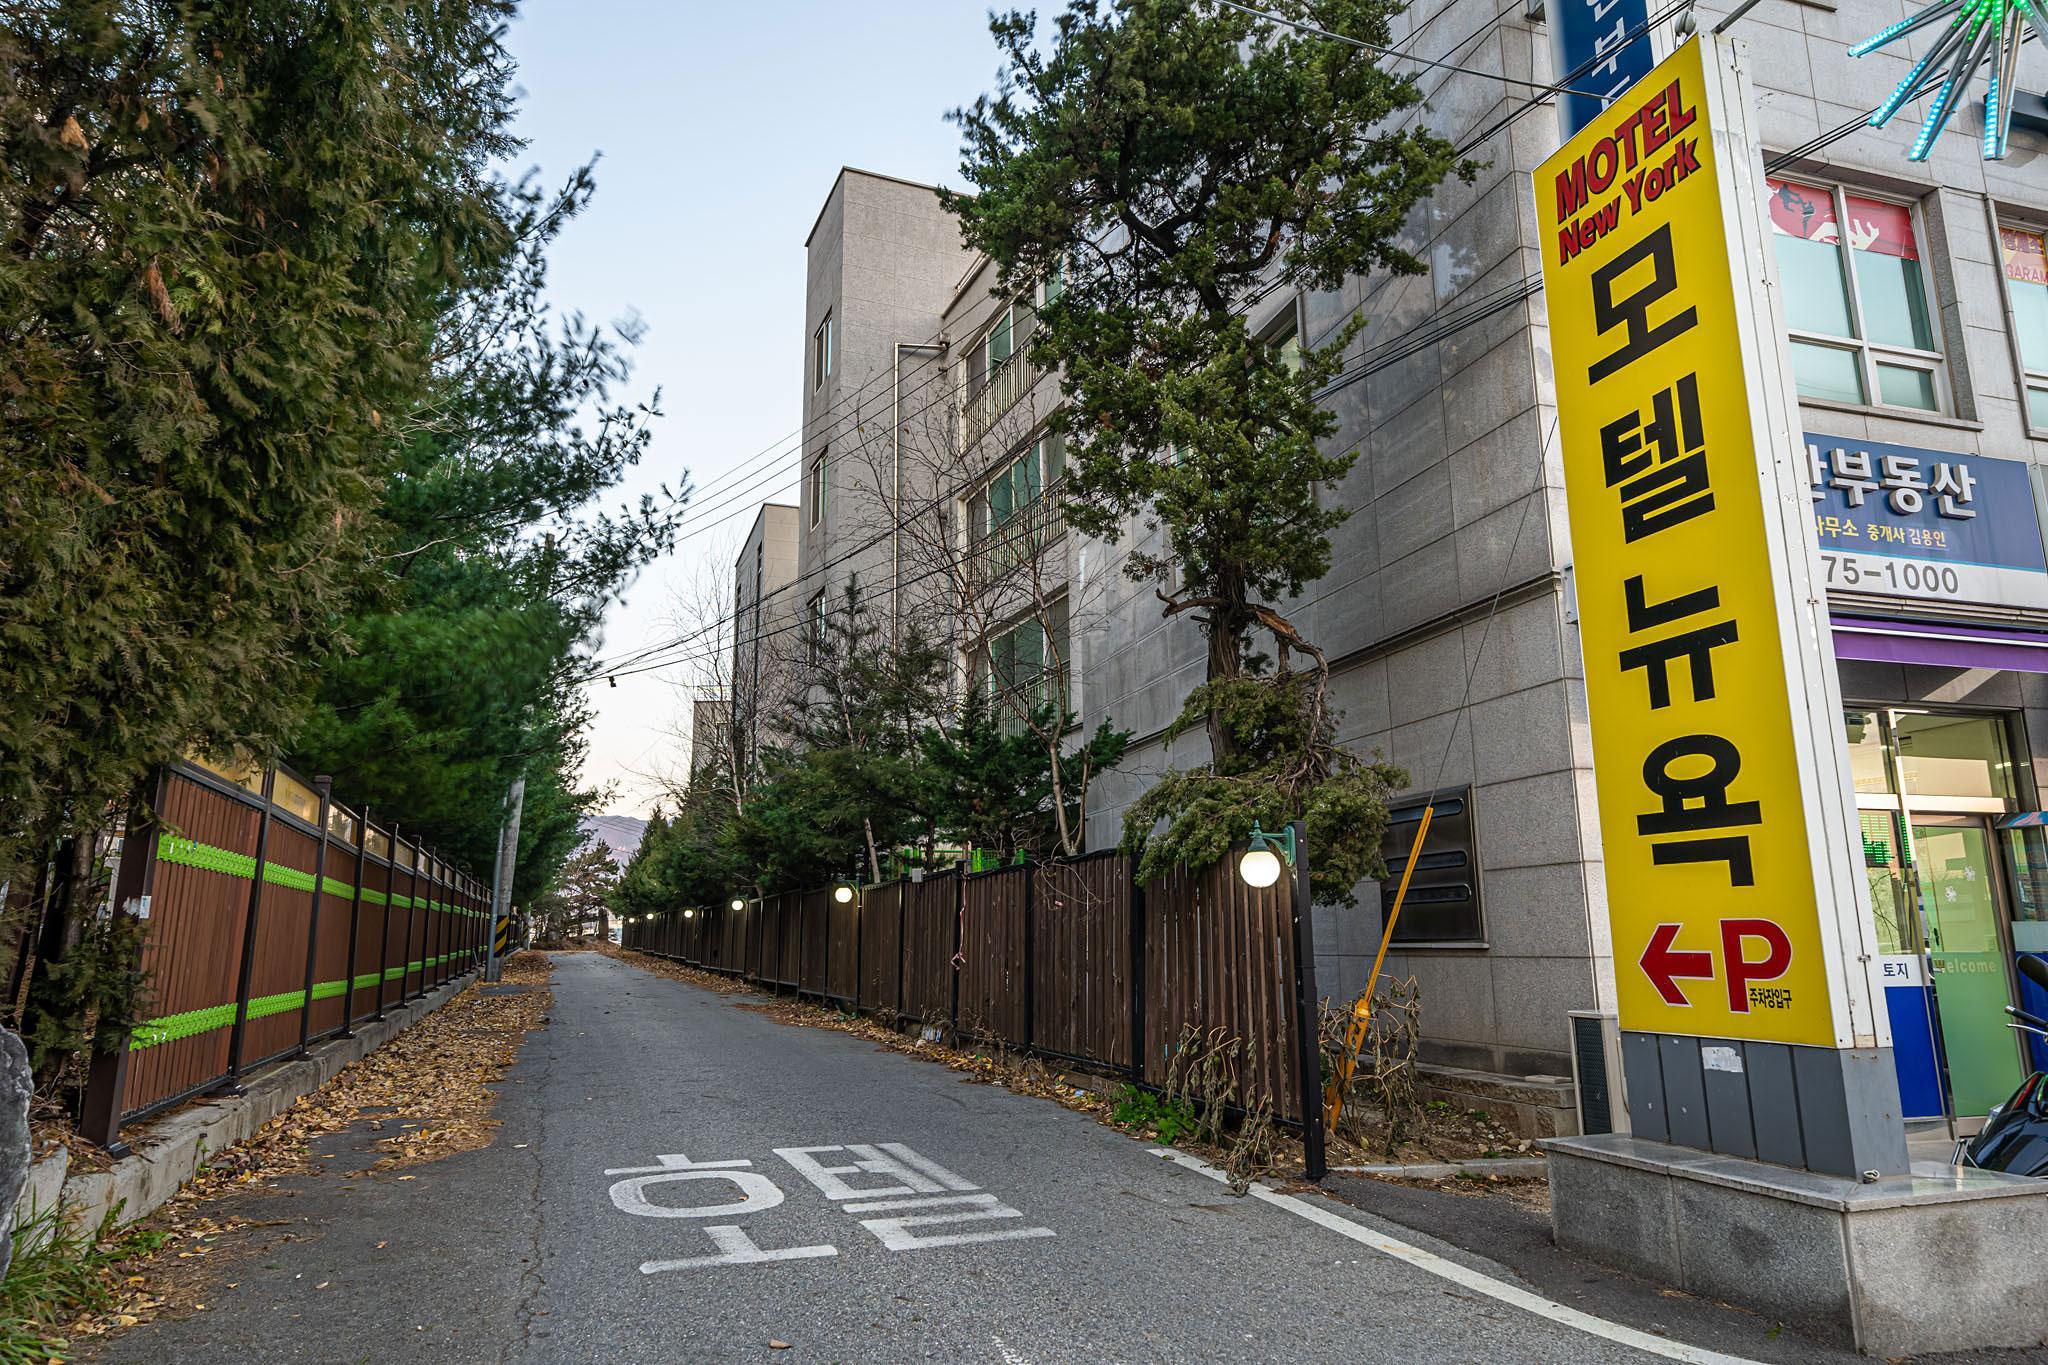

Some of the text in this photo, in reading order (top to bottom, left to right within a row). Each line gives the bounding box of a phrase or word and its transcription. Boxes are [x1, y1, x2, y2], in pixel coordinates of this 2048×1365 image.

[1556, 78, 1696, 225] MOTEL
[1558, 136, 1702, 266] New York
[1867, 523, 1905, 543] 중개사
[1908, 528, 1946, 547] 김용인
[1821, 555, 1959, 594] 75-1000
[1719, 918, 1792, 1014] P
[1749, 988, 1792, 1009] 주차장입구
[1884, 963, 1909, 979] 토지
[603, 1142, 1056, 1275] 호텔
